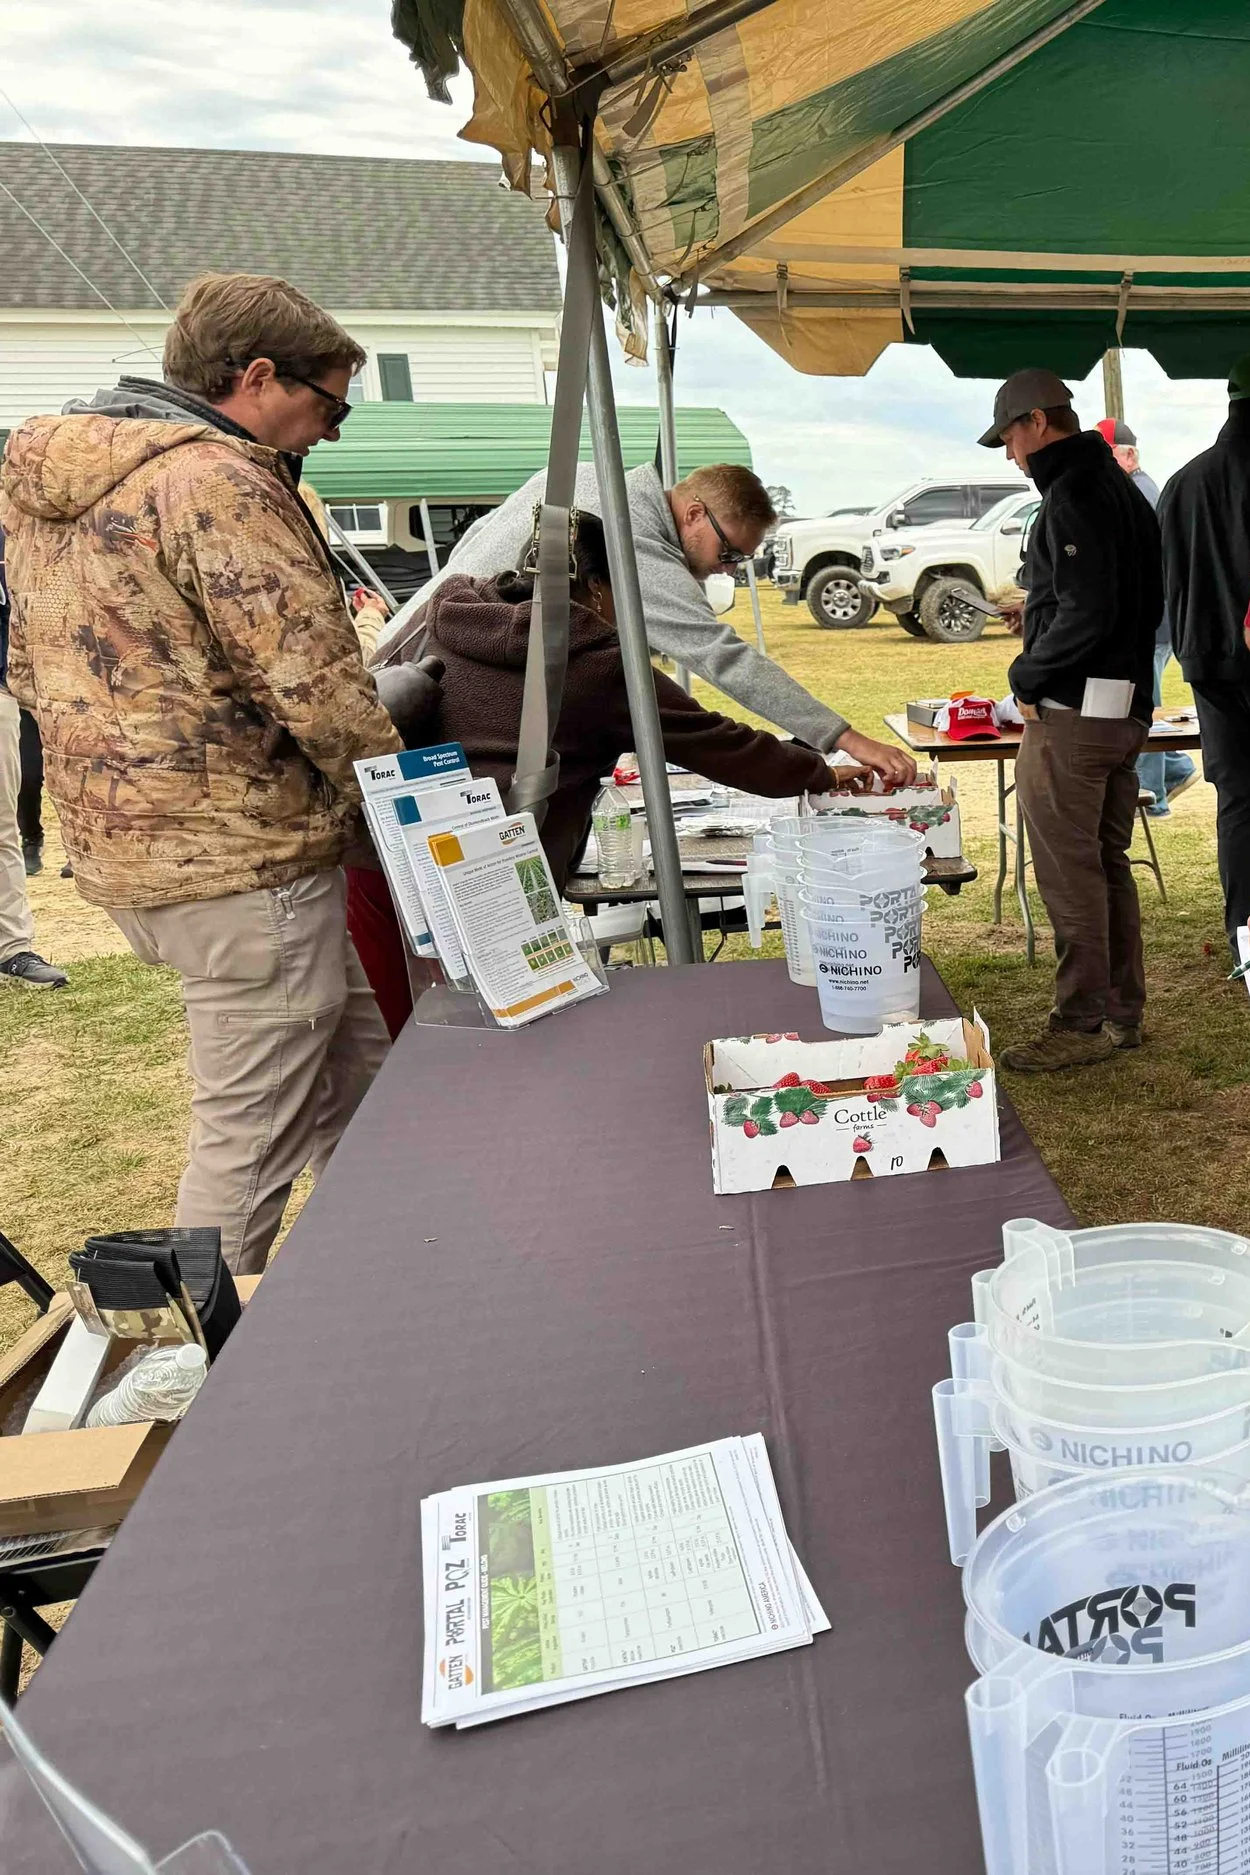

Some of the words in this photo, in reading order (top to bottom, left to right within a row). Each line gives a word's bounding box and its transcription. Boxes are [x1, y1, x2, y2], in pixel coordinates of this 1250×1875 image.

[443, 756, 460, 766] Control
[499, 826, 526, 841] GATTEN
[830, 965, 882, 976] NICHINO
[834, 1105, 887, 1124] Cottle
[852, 1123, 875, 1132] farms
[1061, 1438, 1193, 1467] NICHINO
[445, 1599, 465, 1646] PORTAL
[447, 1654, 463, 1690] GATTEN
[1176, 1759, 1199, 1771] Fluid
[1201, 1758, 1213, 1767] Oz
[1173, 1782, 1187, 1791] 64
[1173, 1794, 1187, 1803] 60
[1173, 1808, 1188, 1817] 56
[1174, 1820, 1188, 1829] 52
[1120, 1828, 1134, 1836] 36
[1174, 1833, 1188, 1842] 48
[1121, 1841, 1135, 1849] 32
[1174, 1847, 1188, 1855] 44
[1121, 1855, 1136, 1864] 28
[1174, 1859, 1188, 1868] 40
